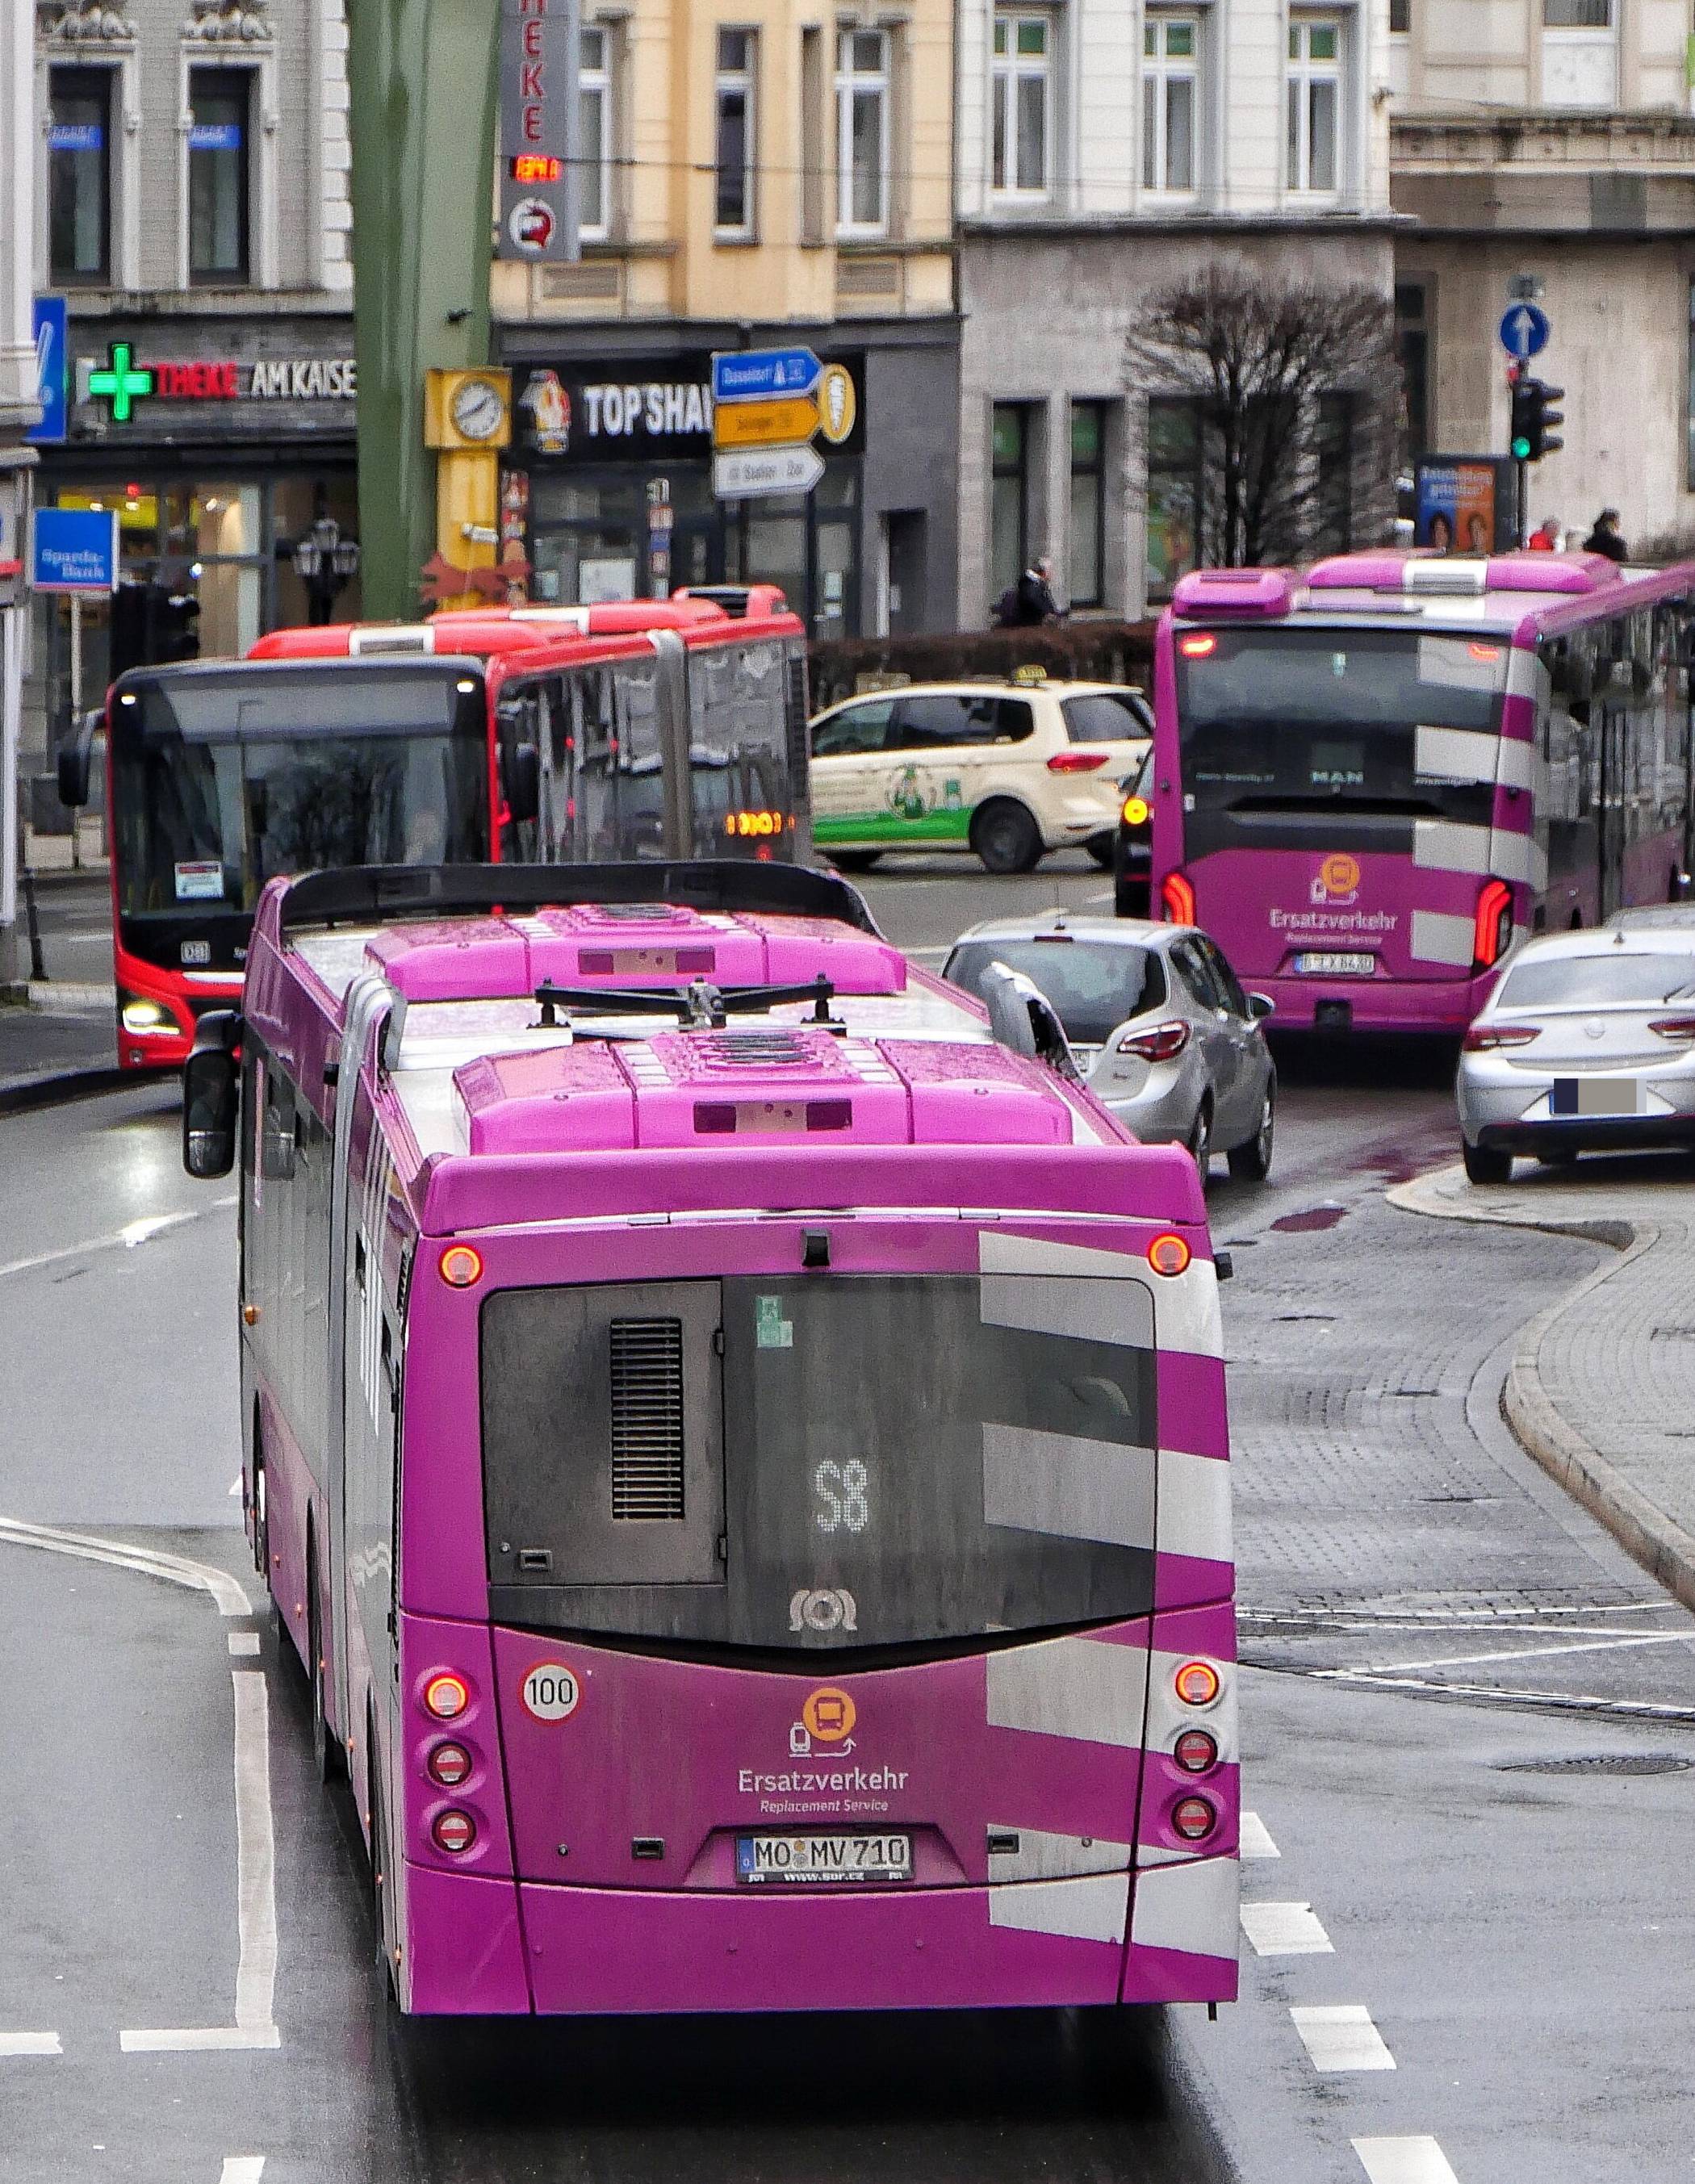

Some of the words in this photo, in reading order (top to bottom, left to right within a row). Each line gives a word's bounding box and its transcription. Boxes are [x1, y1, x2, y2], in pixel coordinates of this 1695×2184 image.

[251, 360, 289, 398] AM
[583, 383, 642, 436] TOP
[1270, 908, 1398, 931] Ersatzverkehr
[815, 1459, 868, 1533] S8
[529, 1677, 573, 1706] 100
[738, 1765, 910, 1793] Ersatzverkehr
[760, 1798, 840, 1814] Replacement
[843, 1799, 889, 1812] Service
[755, 1840, 791, 1868] MO
[810, 1839, 847, 1868] MV
[852, 1838, 905, 1866] 710
